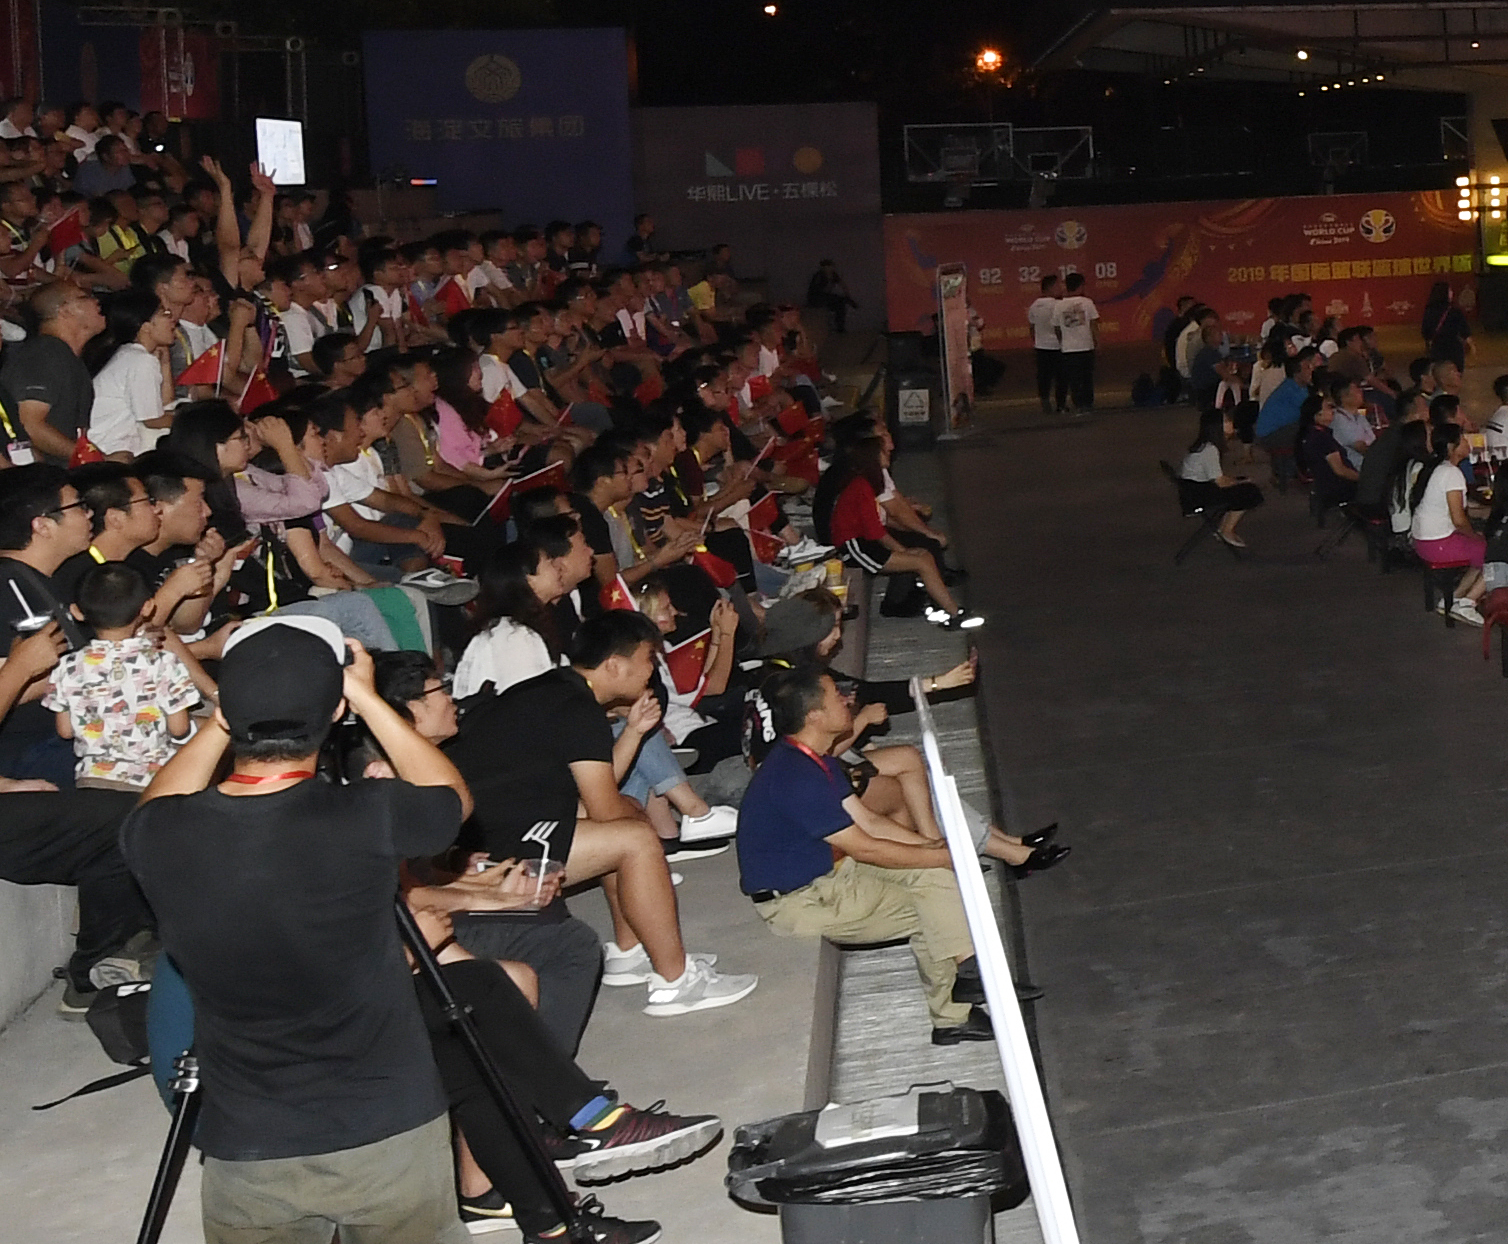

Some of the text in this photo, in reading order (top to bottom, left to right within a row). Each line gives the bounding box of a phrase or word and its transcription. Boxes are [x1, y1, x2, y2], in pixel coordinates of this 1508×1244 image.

[1337, 226, 1356, 236] CUP
[979, 268, 1002, 285] 92
[1018, 266, 1041, 283] 32
[1095, 262, 1117, 279] 08
